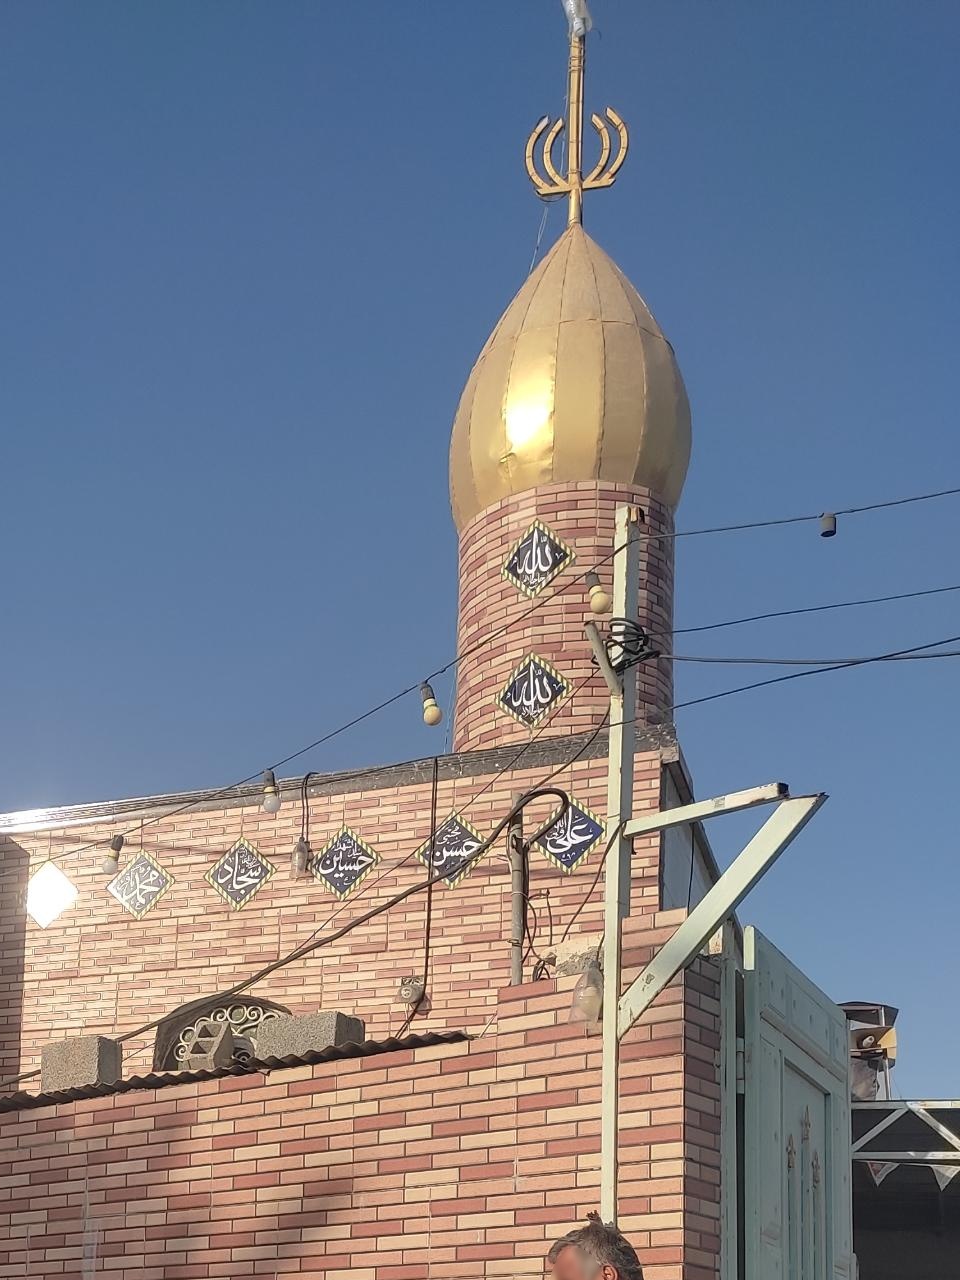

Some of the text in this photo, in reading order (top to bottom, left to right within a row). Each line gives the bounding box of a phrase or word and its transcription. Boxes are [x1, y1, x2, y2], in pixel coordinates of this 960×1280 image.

[516, 528, 553, 581] الله
[511, 661, 552, 713] الله
[319, 851, 374, 878] حسین
